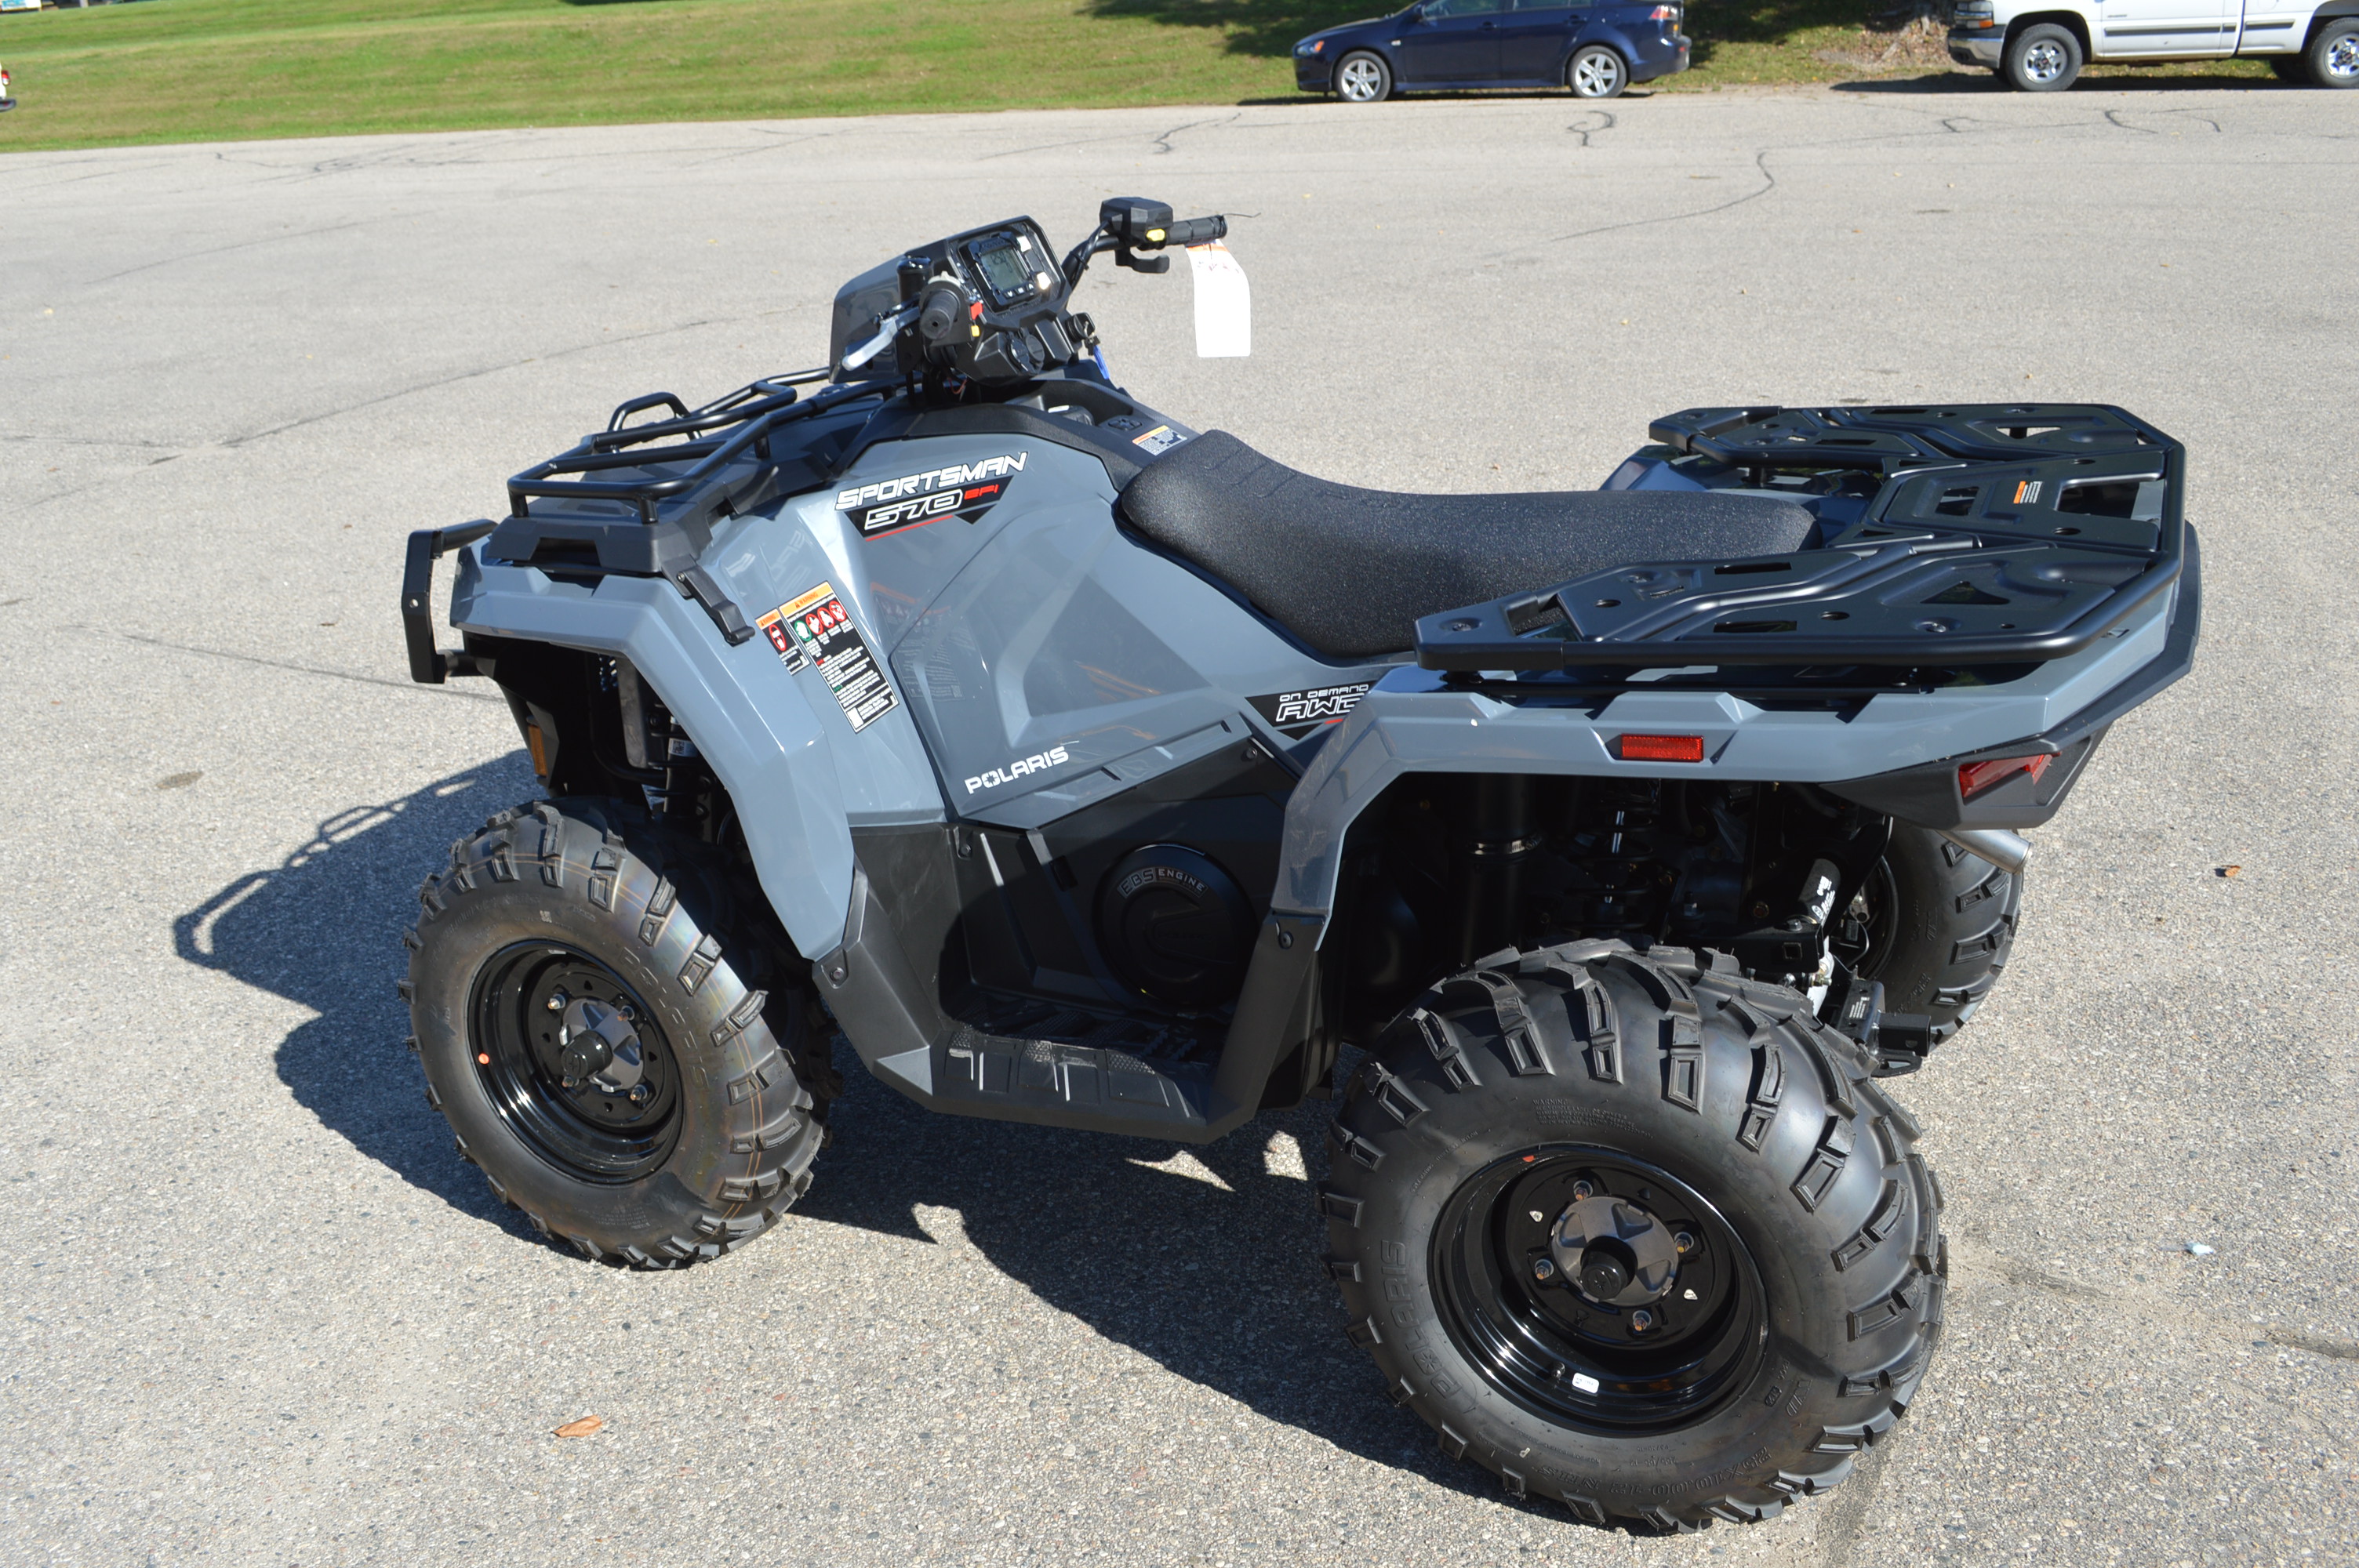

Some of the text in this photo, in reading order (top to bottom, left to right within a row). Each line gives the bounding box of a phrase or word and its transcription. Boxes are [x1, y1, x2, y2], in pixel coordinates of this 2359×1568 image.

[834, 451, 1029, 511] SPORTSMAN
[864, 484, 1000, 531] 570 EFI
[1279, 684, 1369, 702] ON DEMAND
[964, 746, 1070, 795] POLARIS
[1121, 868, 1154, 896] EBS
[1158, 868, 1205, 892] ENGINE
[1380, 1239, 1463, 1399] POLARIS
